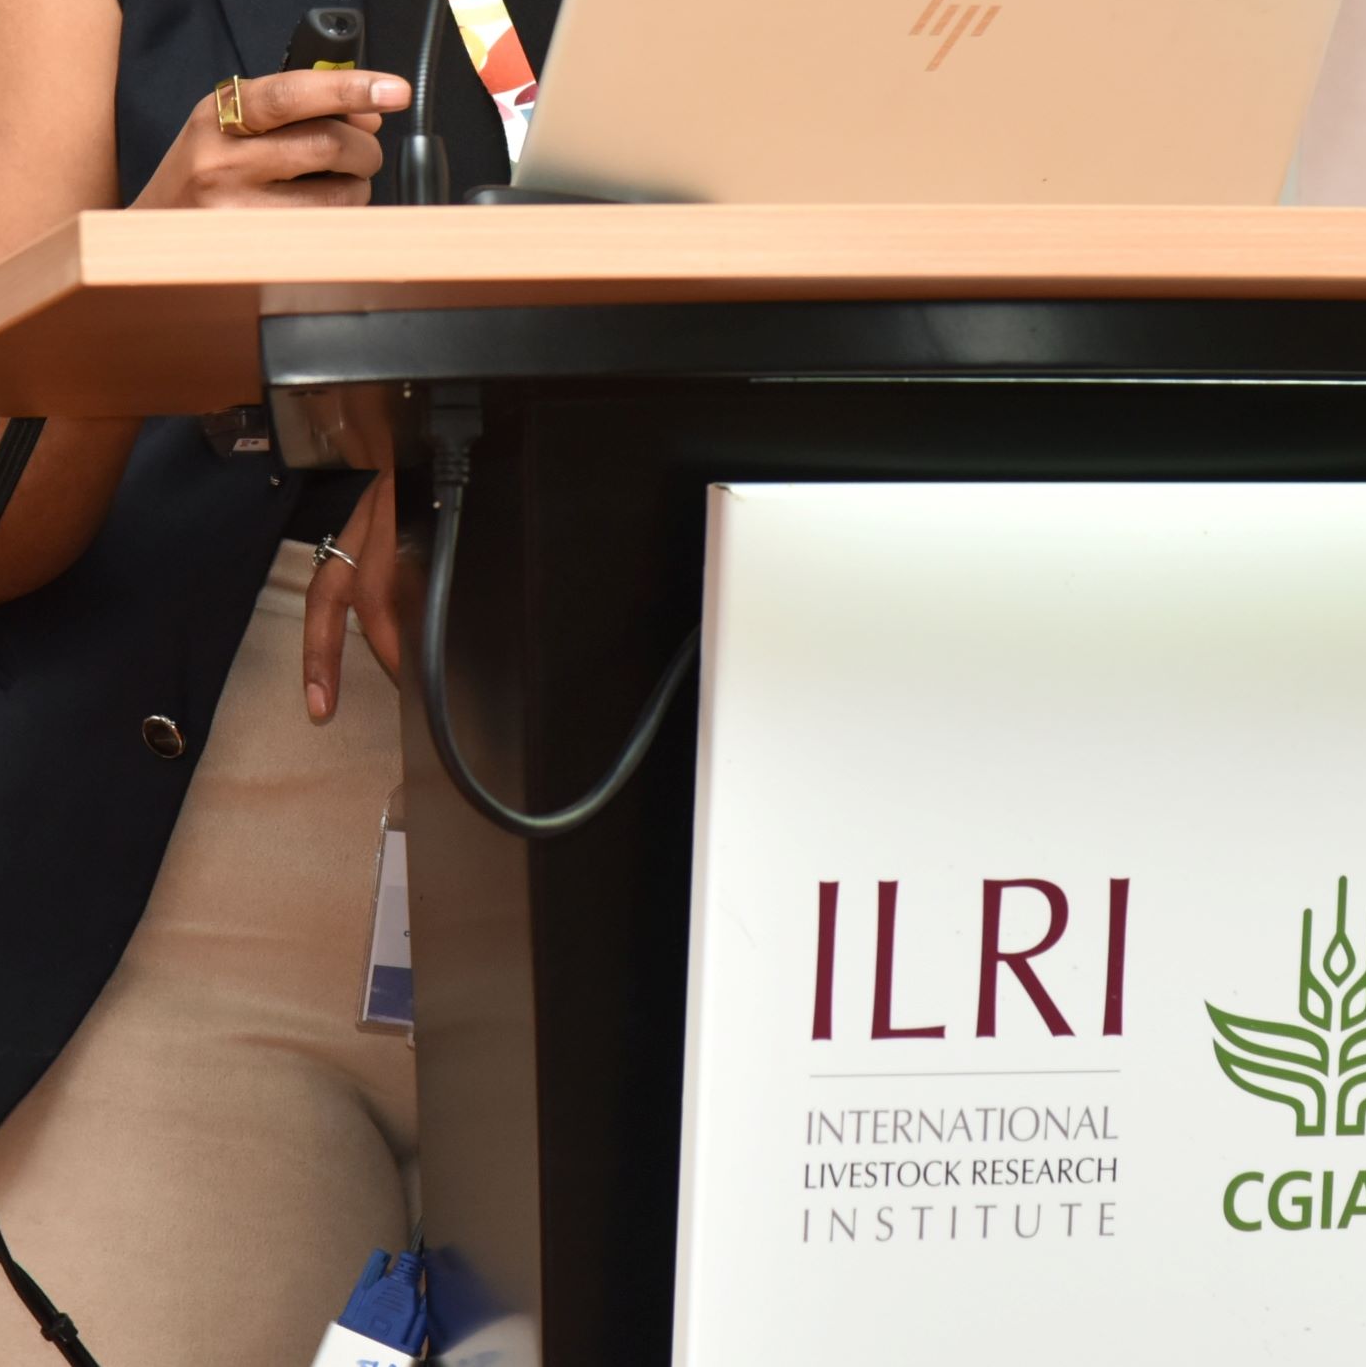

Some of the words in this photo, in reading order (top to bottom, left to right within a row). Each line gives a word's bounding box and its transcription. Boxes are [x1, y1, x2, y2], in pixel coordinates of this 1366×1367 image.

[810, 876, 1132, 1042] ILRI
[804, 1104, 1119, 1146] INTERNATIONAL
[802, 1160, 962, 1190] LIVESTOCK
[971, 1156, 1118, 1187] RESEARCH
[801, 1200, 1117, 1244] INSTITUTE
